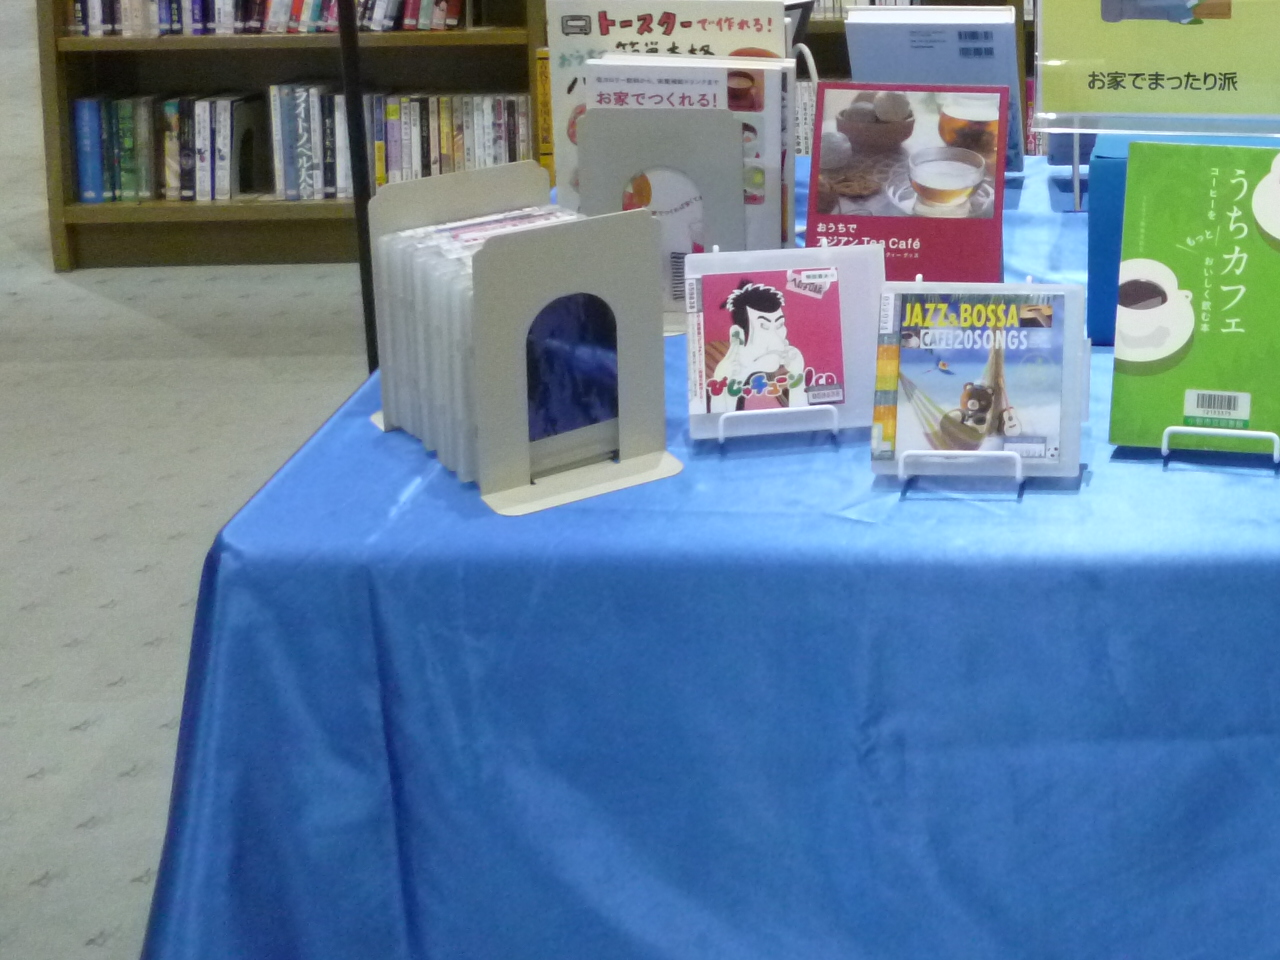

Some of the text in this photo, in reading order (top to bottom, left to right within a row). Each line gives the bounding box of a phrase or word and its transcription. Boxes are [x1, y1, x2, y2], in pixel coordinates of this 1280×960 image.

[598, 10, 773, 37] トースターで作れる!
[1087, 71, 1238, 92] お家でまったり派
[596, 91, 719, 109] お家でつくれる!
[1208, 167, 1219, 221] コーヒーを
[816, 222, 857, 233] おうちで
[889, 237, 921, 250] Café
[1220, 168, 1248, 333] うちカフェ
